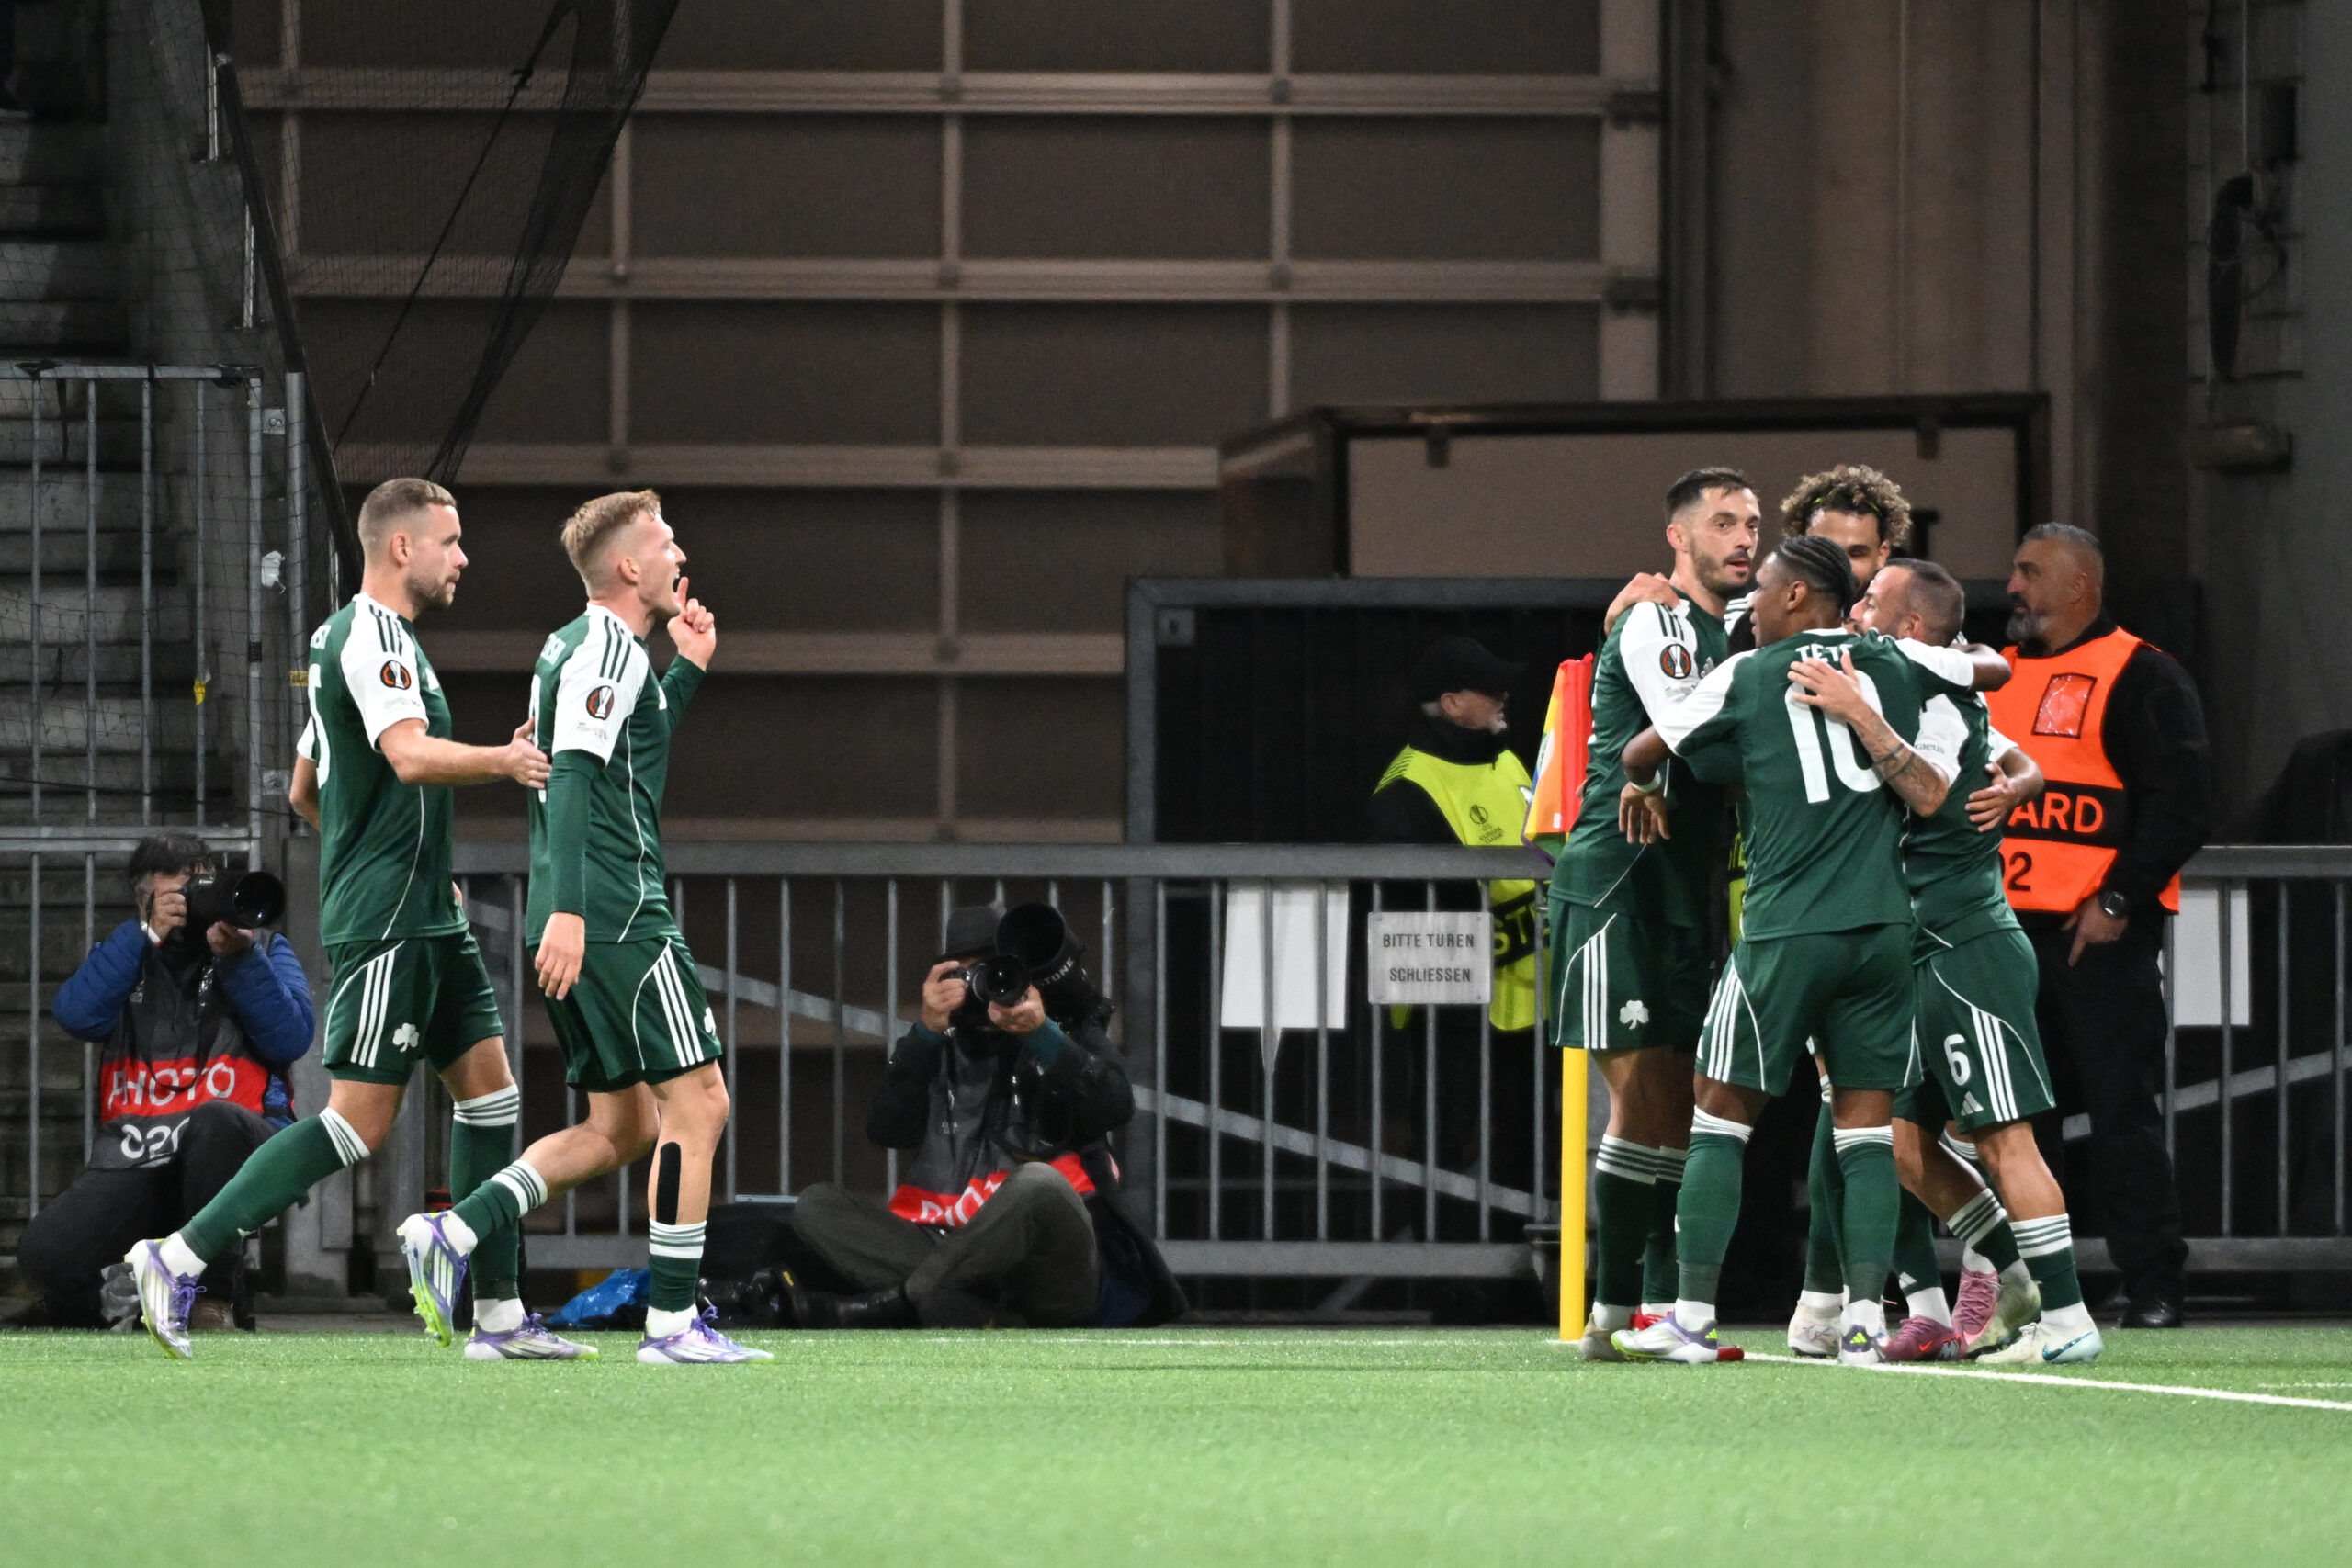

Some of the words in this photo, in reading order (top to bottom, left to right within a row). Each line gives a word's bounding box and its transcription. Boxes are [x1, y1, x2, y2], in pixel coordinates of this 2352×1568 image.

[1785, 670, 1883, 804] 10
[2007, 792, 2104, 834] ARD
[1997, 851, 2032, 892] 2
[1383, 933, 1421, 948] BITTE
[1389, 967, 1471, 982] SCHLIESSEN
[1943, 1033, 1971, 1086] 6
[108, 1062, 235, 1110] PHOTO
